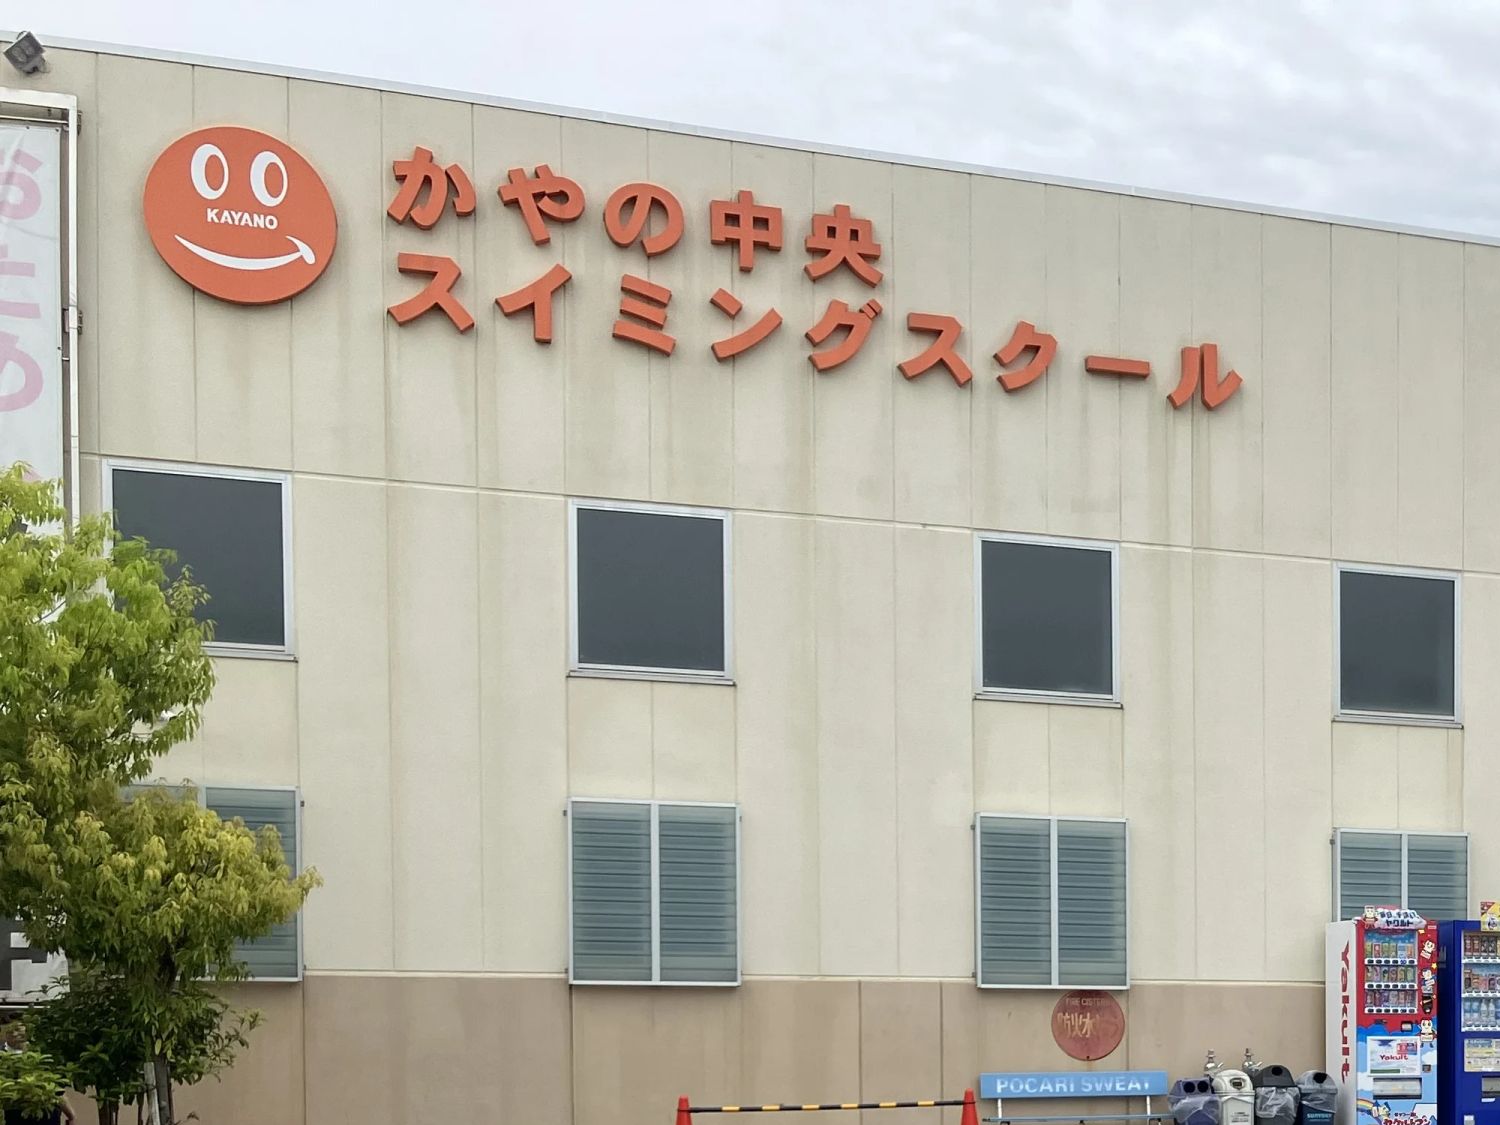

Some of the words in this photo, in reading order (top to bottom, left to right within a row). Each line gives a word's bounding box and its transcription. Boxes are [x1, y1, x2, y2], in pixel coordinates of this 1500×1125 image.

[206, 207, 279, 230] KAYANO
[387, 146, 884, 288] かやの中央
[387, 251, 1244, 411] スイミングスクール
[1340, 939, 1350, 1084] Yakult
[996, 1078, 1075, 1093] POCARI
[1081, 1077, 1150, 1092] SWEAT
